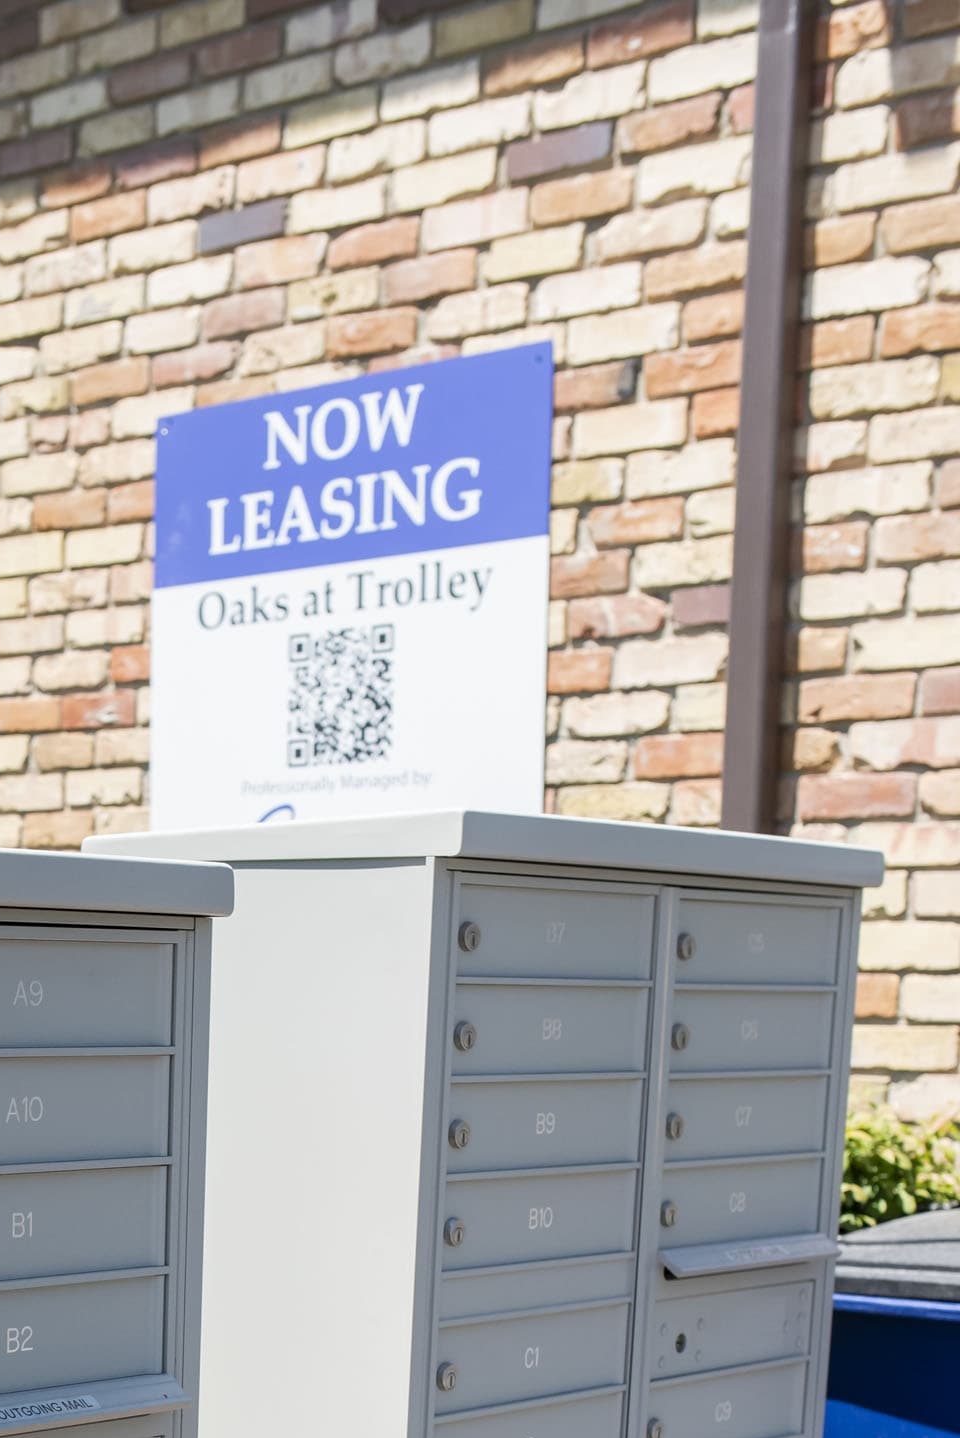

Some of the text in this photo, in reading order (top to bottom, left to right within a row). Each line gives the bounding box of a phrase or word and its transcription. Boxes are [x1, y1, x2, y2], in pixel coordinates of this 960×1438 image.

[263, 384, 424, 470] NOW
[207, 457, 482, 556] LEASING
[197, 561, 493, 631] Oaks at Trolley
[340, 771, 409, 790] Managed
[13, 981, 43, 1006] A9
[6, 1096, 43, 1123] A10
[536, 1113, 555, 1134] B9
[12, 1212, 32, 1238] B1
[529, 1207, 553, 1229] B10
[7, 1326, 33, 1353] B2
[525, 1347, 539, 1368] C1
[61, 1398, 93, 1411] MAIL
[715, 1400, 732, 1422] C9
